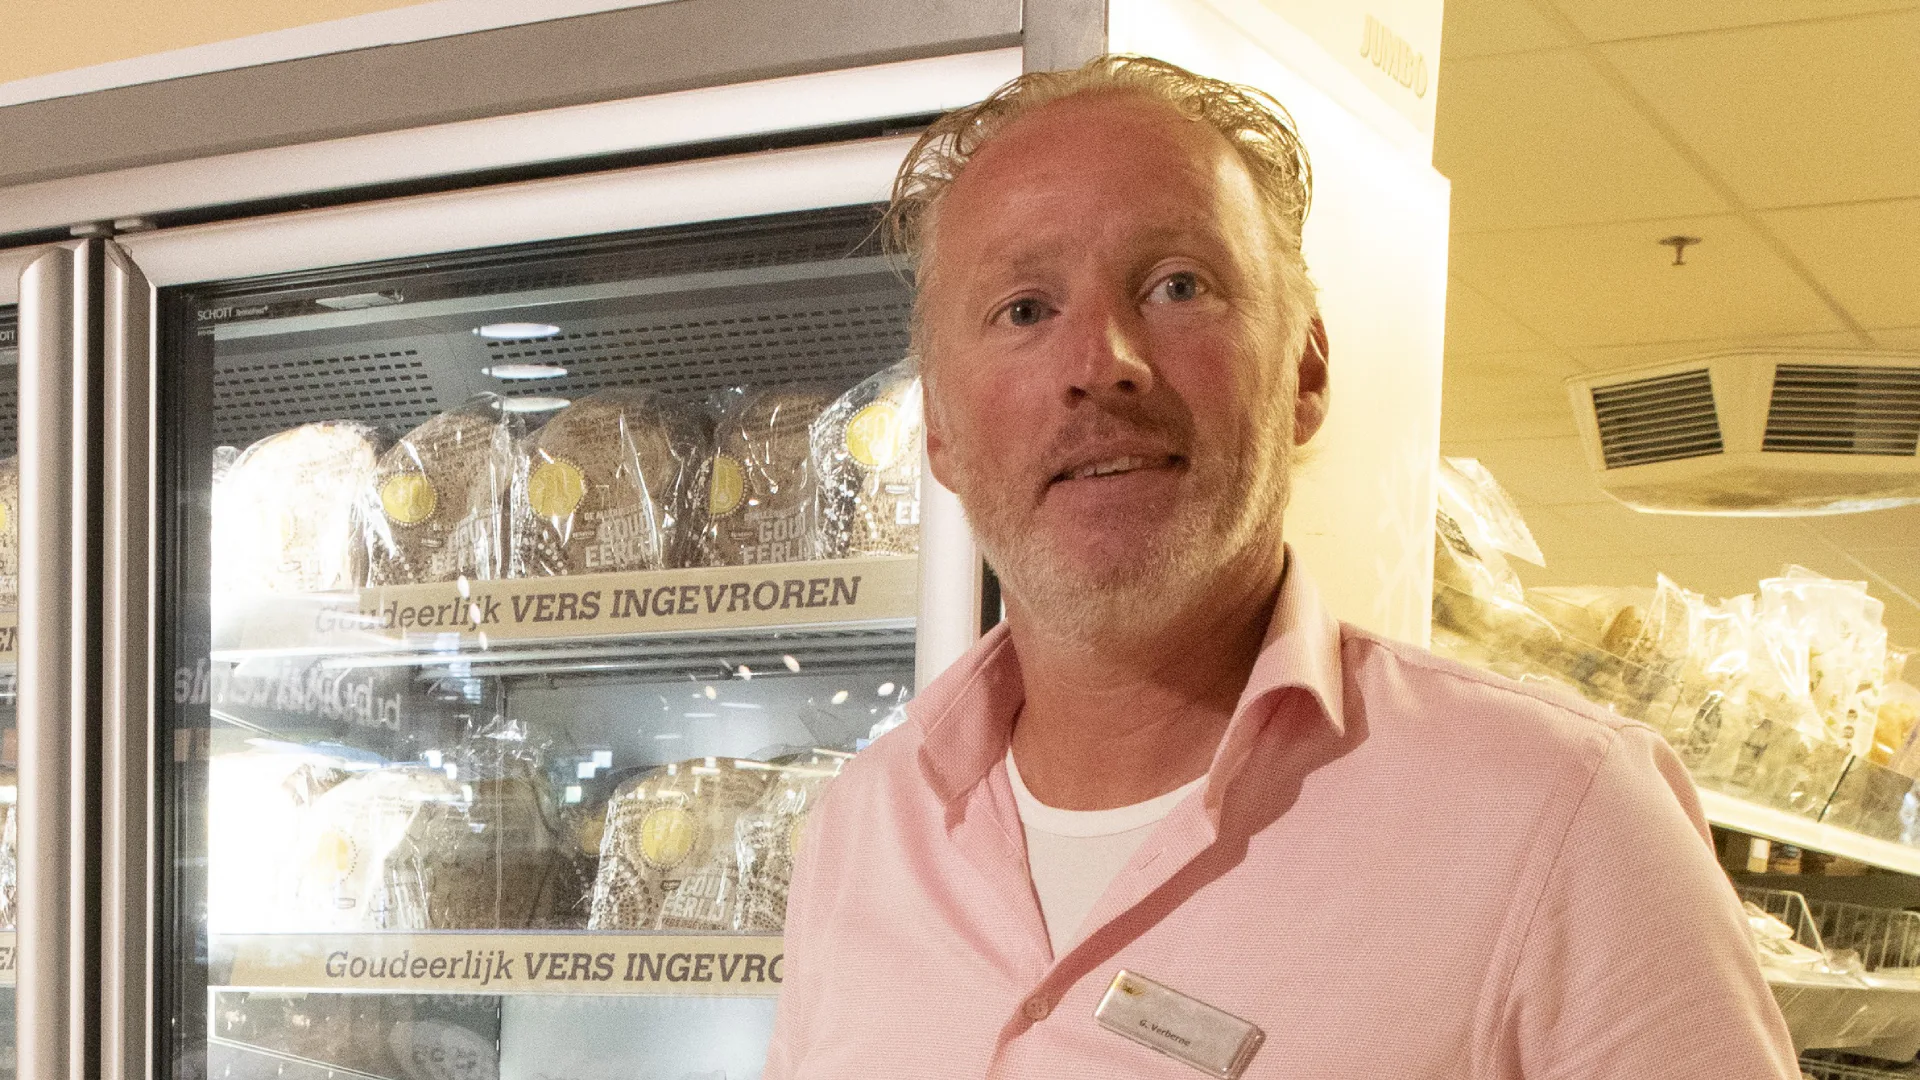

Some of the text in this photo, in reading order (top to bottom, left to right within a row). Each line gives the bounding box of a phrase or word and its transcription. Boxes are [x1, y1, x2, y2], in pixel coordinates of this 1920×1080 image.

[197, 306, 233, 321] SCHOTT
[315, 576, 862, 634] Goudeerlijk VERS INGEVROREN
[325, 949, 513, 986] Goudeerlijk
[524, 952, 615, 982] VERS
[1139, 1019, 1191, 1046] G. Verberne
